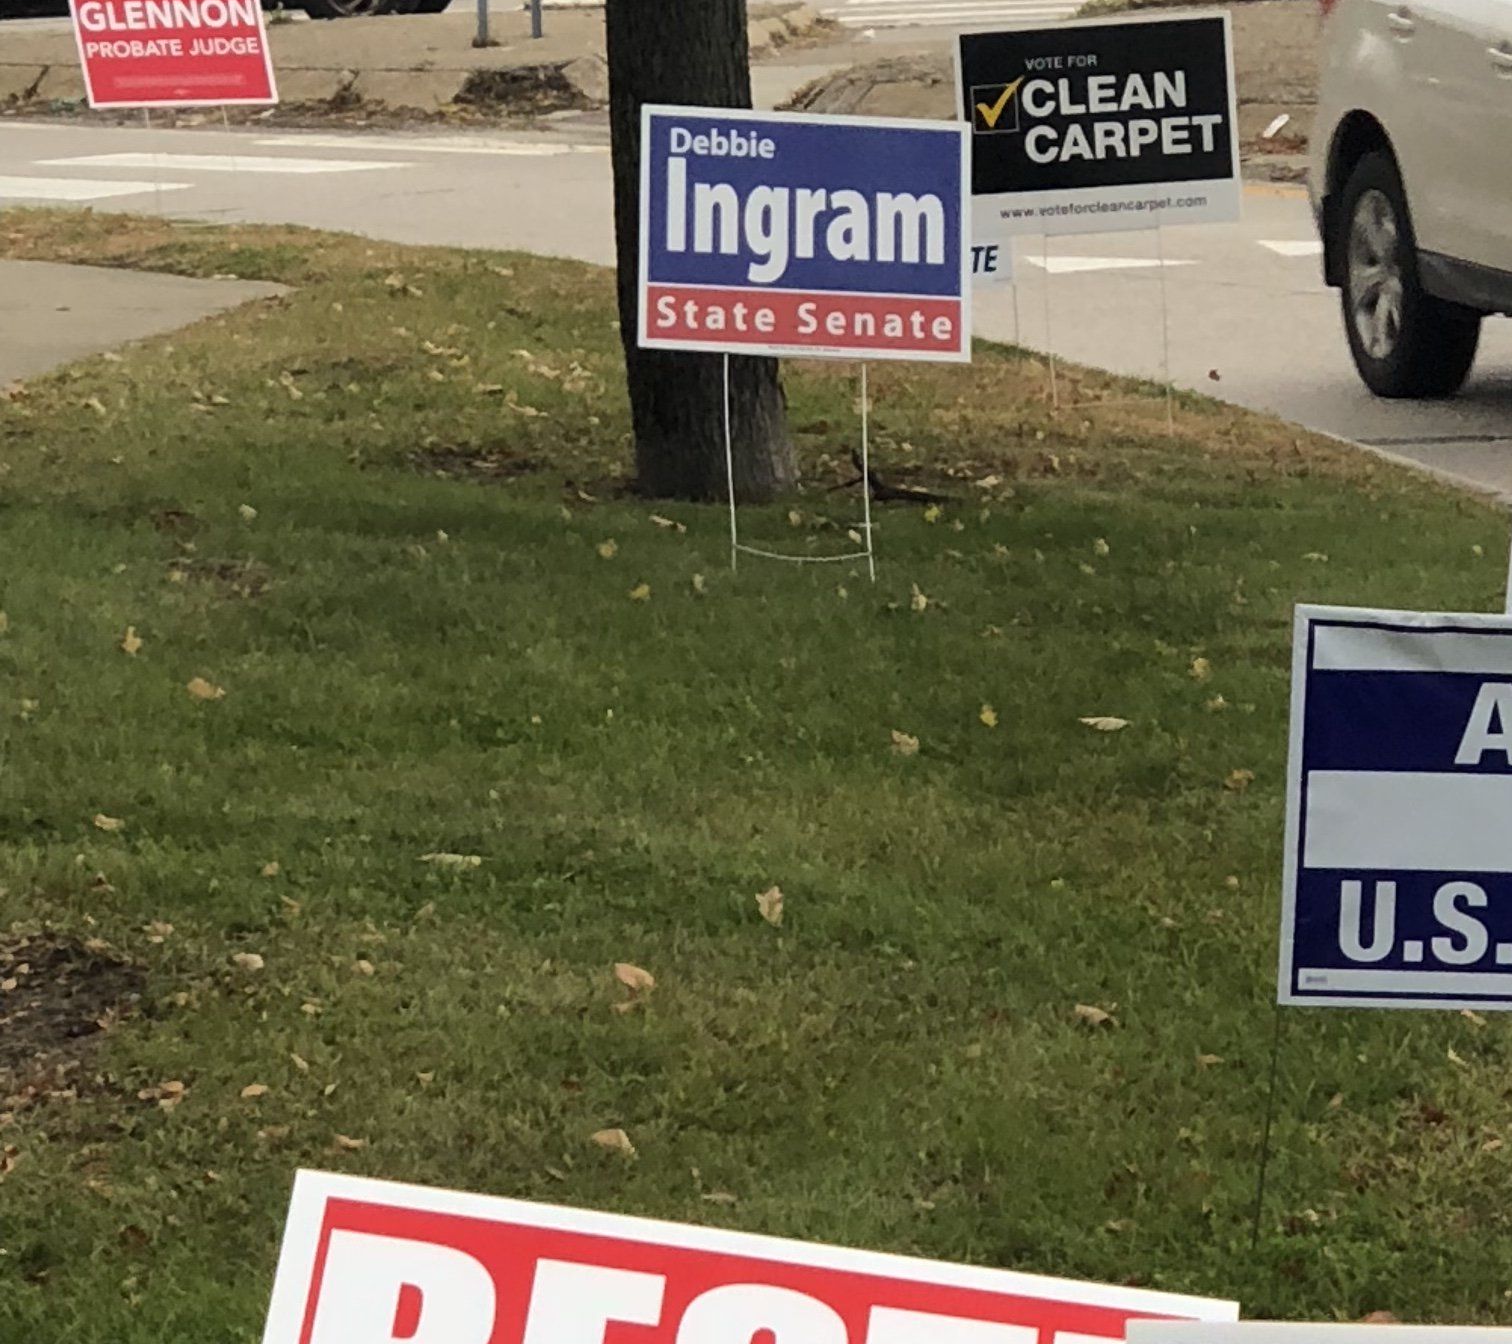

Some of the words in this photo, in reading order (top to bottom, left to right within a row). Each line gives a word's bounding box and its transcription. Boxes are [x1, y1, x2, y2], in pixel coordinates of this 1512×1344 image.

[86, 38, 184, 59] PROBATE
[189, 37, 260, 56] JUDGE
[1025, 57, 1063, 71] VOTE
[1067, 54, 1098, 68] FOR
[1021, 70, 1187, 117] CLEAN
[670, 127, 776, 158] Debbie
[1024, 114, 1223, 163] CARPET
[666, 156, 945, 283] Ingram
[1000, 194, 1207, 219] www.voteforcleancarpet.com
[656, 296, 775, 332] State
[797, 303, 952, 340] Senate
